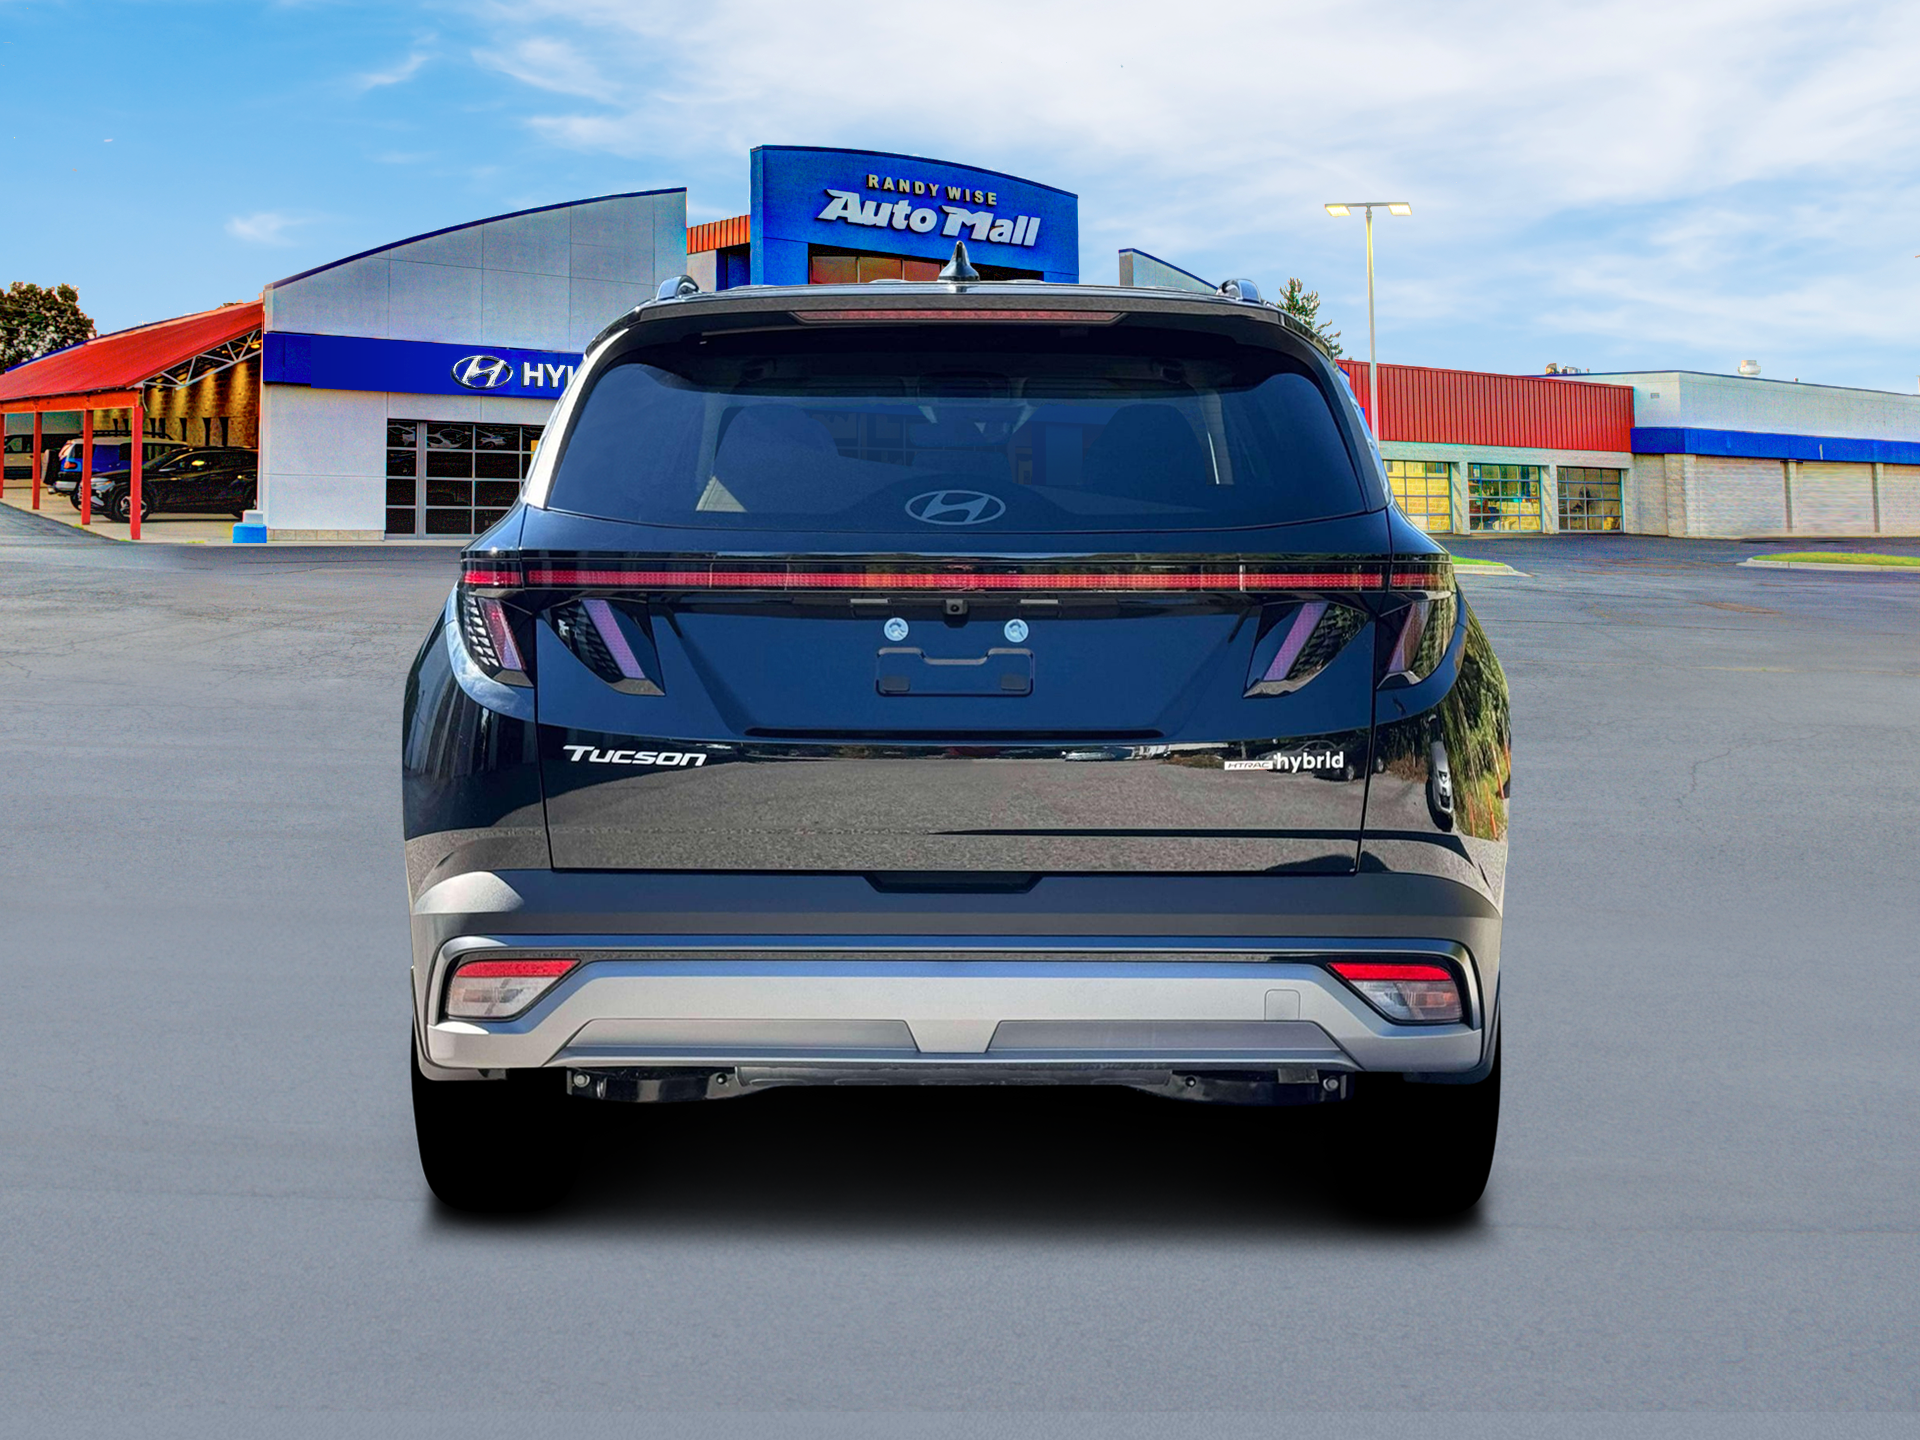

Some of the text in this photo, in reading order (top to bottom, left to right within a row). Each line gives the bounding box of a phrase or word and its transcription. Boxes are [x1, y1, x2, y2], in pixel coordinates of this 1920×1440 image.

[867, 173, 998, 206] RANDY WISE
[816, 188, 1042, 247] Auto Mall
[1225, 751, 1344, 773] HTRAC hybrid
